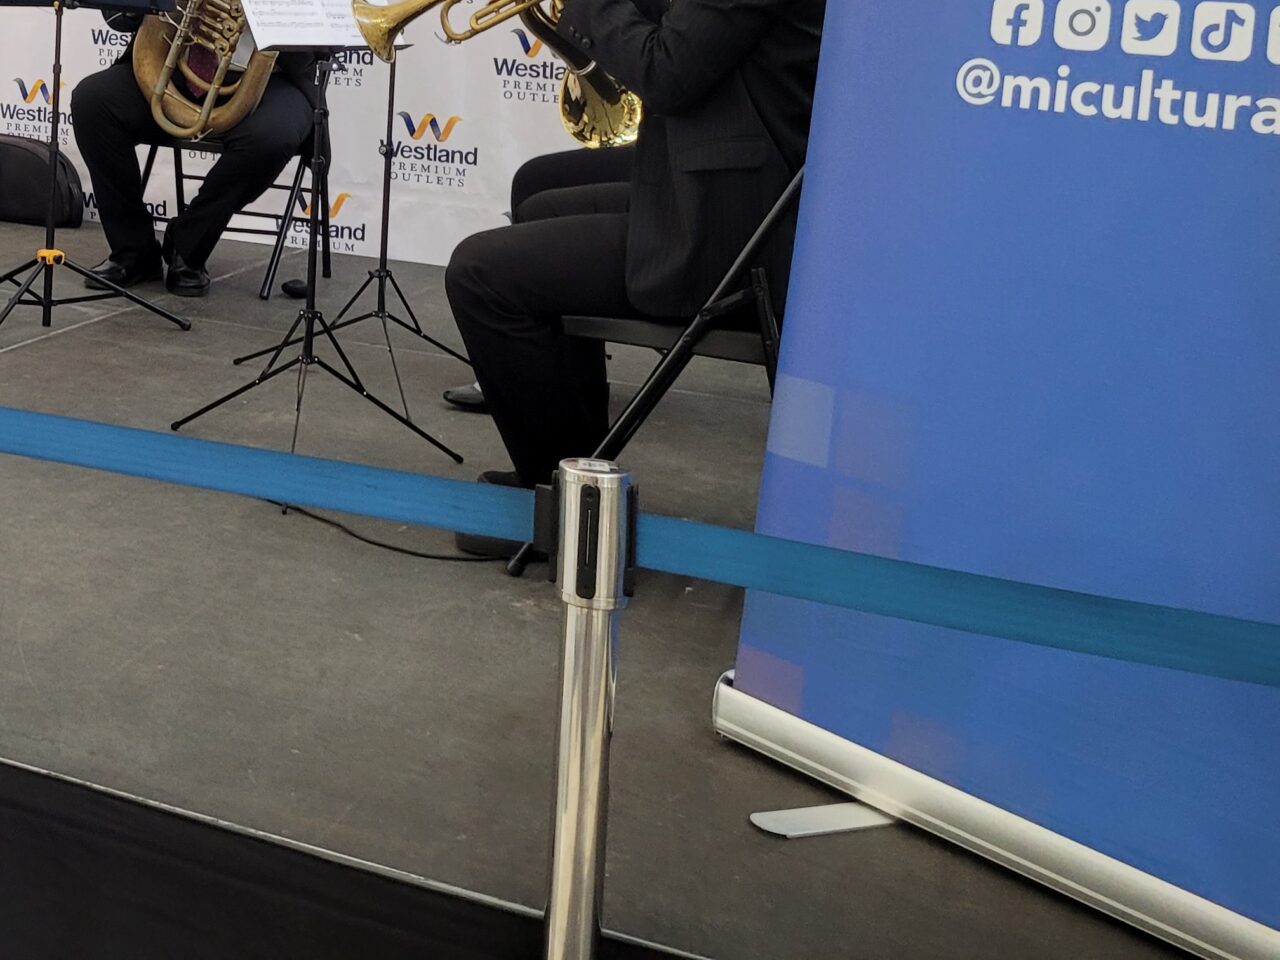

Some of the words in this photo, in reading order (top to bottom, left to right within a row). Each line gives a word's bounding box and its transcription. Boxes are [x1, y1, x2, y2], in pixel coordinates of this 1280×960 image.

[493, 58, 567, 81] Westla
[503, 80, 555, 92] PREMI
[504, 90, 559, 104] OUTLE
[955, 56, 1280, 136] @micultura
[7, 123, 70, 136] PREMIM
[392, 161, 467, 177] REMIUM
